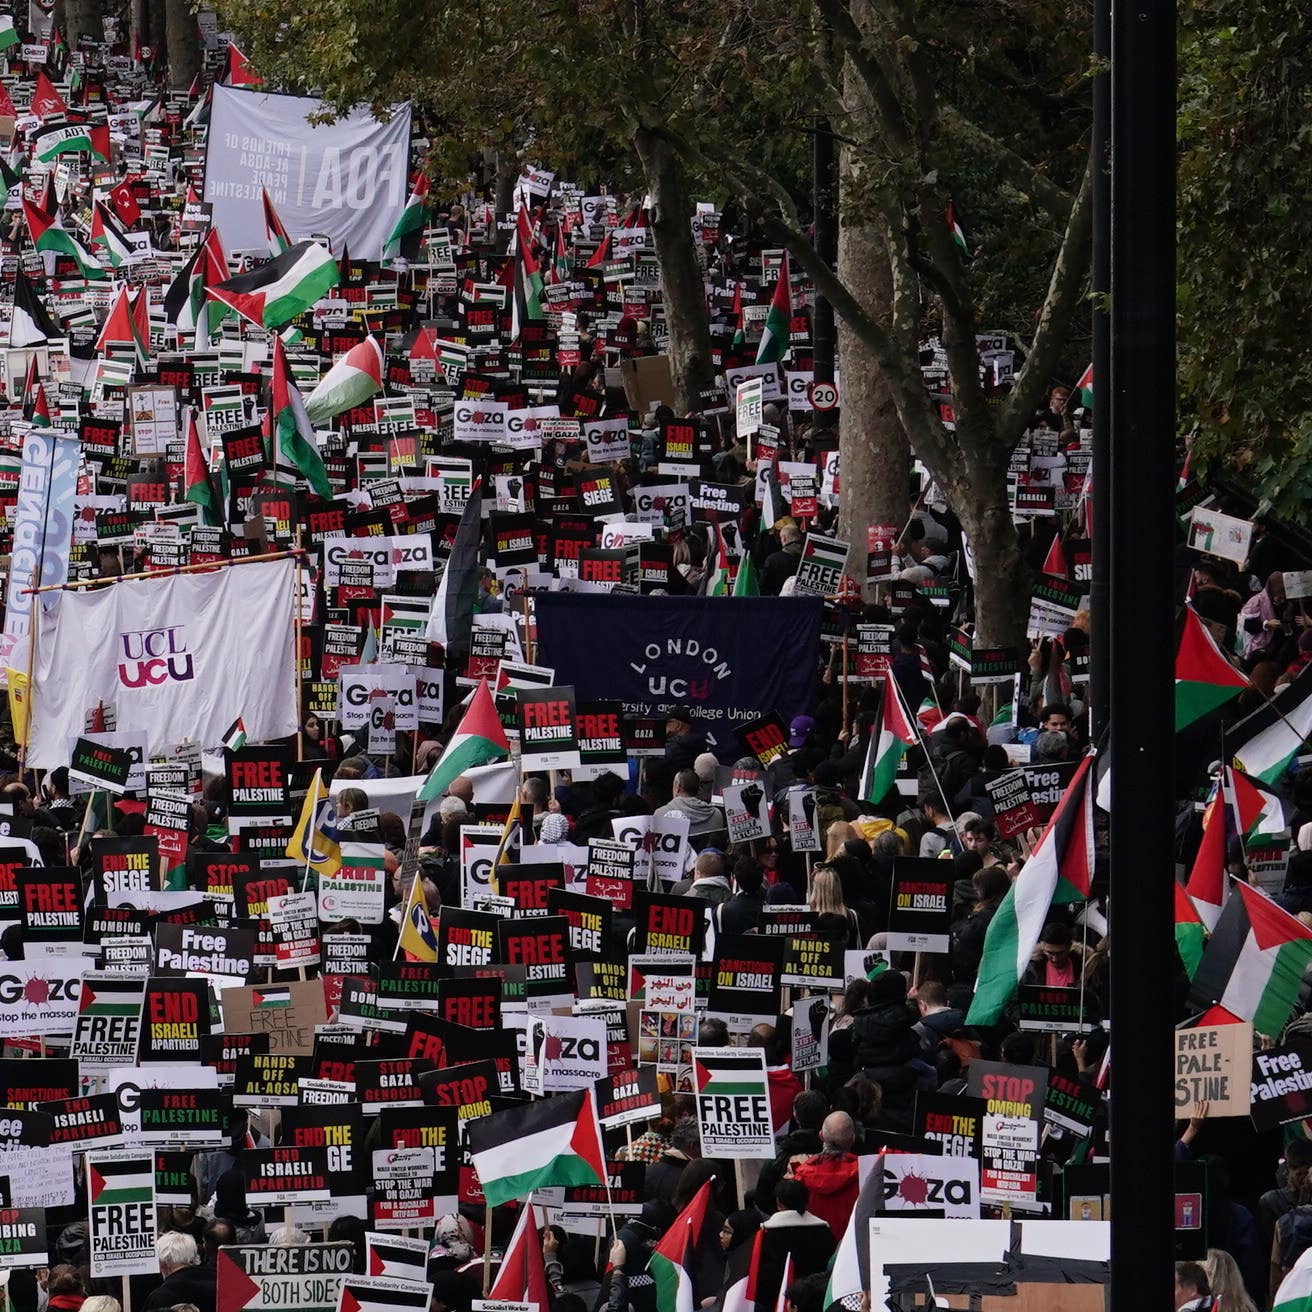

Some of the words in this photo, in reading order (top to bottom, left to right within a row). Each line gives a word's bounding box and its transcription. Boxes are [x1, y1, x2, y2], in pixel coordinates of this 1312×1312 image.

[814, 387, 835, 405] 20
[206, 411, 242, 427] FREE
[84, 427, 117, 443] FREE
[82, 442, 119, 455] PALESTINE
[225, 437, 261, 457] FREE
[229, 448, 264, 468] PALESTINE
[583, 489, 613, 506] SIEGE
[699, 484, 728, 499] Free
[122, 629, 188, 660] UCL
[630, 639, 731, 680] LONDON
[118, 654, 194, 688] UCU
[649, 677, 709, 699] UCU
[524, 702, 570, 727] FREE
[728, 708, 761, 720] Union
[525, 725, 572, 740] PALESTINE
[231, 761, 283, 787] FREE
[232, 788, 284, 802] PALESTINE
[991, 779, 1024, 800] FREEDOM
[151, 798, 188, 814] FREEDOM
[994, 792, 1030, 814] PALESTINE
[147, 814, 187, 830] PALESTINE
[592, 848, 629, 862] FREEDOM
[589, 864, 631, 878] PALESTINE
[103, 870, 150, 892] SIEGE
[26, 884, 77, 911] FREE
[897, 894, 911, 906] ON
[913, 895, 946, 909] ISRAEL
[27, 913, 79, 926] PALESTINE
[182, 930, 226, 951] Free
[792, 940, 830, 952] HANDS
[159, 949, 249, 974] Palestine
[800, 952, 820, 964] OFF
[785, 964, 833, 976] AL-AQSA
[149, 991, 198, 1023] END
[151, 1023, 198, 1039] ISRAELI
[151, 1038, 199, 1051] APARTHEID
[1178, 1031, 1217, 1051] FREE
[254, 1057, 295, 1069] HANDS
[1257, 1052, 1301, 1077] Free
[262, 1069, 284, 1081] OFF
[246, 1081, 298, 1094] AL-AQSA
[1176, 1077, 1230, 1107] STINE
[700, 1096, 767, 1122] FREE
[702, 1123, 770, 1137] PALESTINE
[274, 1149, 299, 1161] END
[260, 1161, 313, 1177] ISRAELI
[250, 1176, 325, 1191] APARTHEID
[93, 1207, 155, 1235] FREE
[93, 1235, 155, 1251] PALESTINE
[240, 1249, 299, 1272] THERE
[303, 1249, 318, 1268] IS
[322, 1247, 351, 1267] NO
